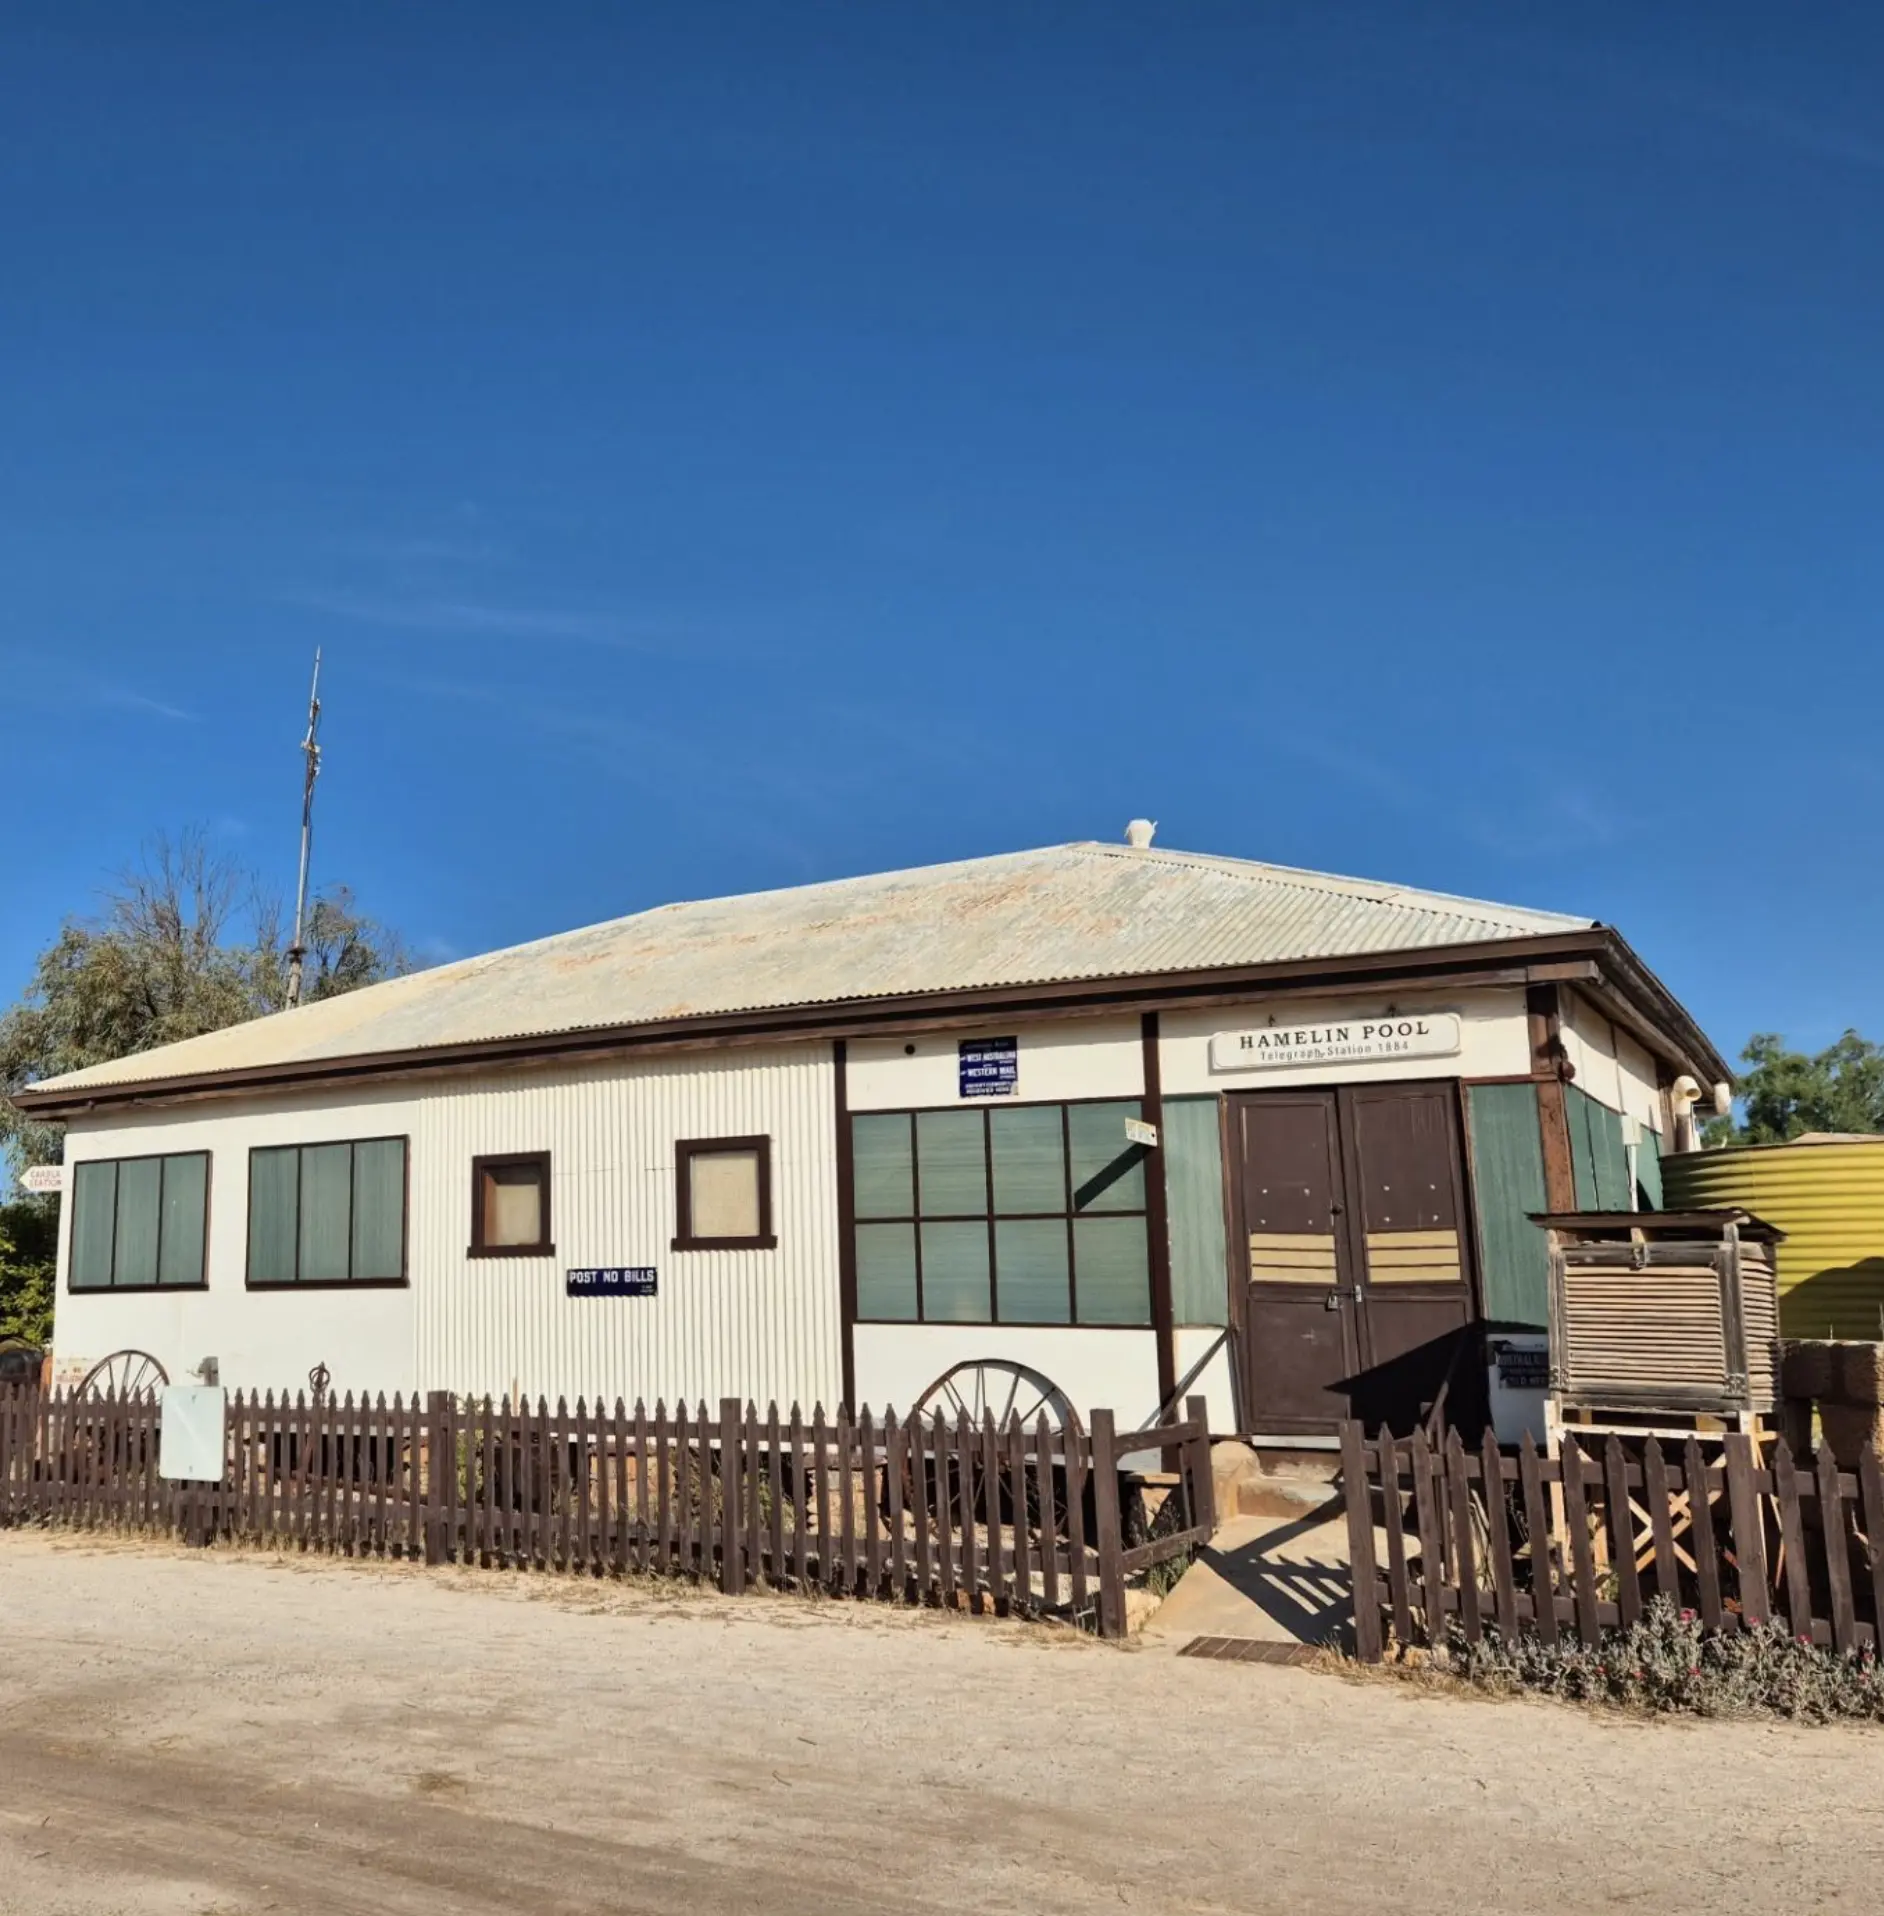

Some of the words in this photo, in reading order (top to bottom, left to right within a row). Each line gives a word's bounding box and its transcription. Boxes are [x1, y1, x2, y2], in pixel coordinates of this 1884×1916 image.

[1240, 1027, 1350, 1050] HAMELIN
[1362, 1021, 1430, 1040] POOL
[1260, 1047, 1322, 1061] Telegraph
[1327, 1044, 1372, 1056] Station
[1377, 1041, 1409, 1052] 1884
[967, 1067, 998, 1077] WESTERN
[999, 1065, 1016, 1074] MAIL
[569, 1271, 598, 1284] POST
[603, 1270, 619, 1283] NO
[624, 1269, 655, 1283] BILLS
